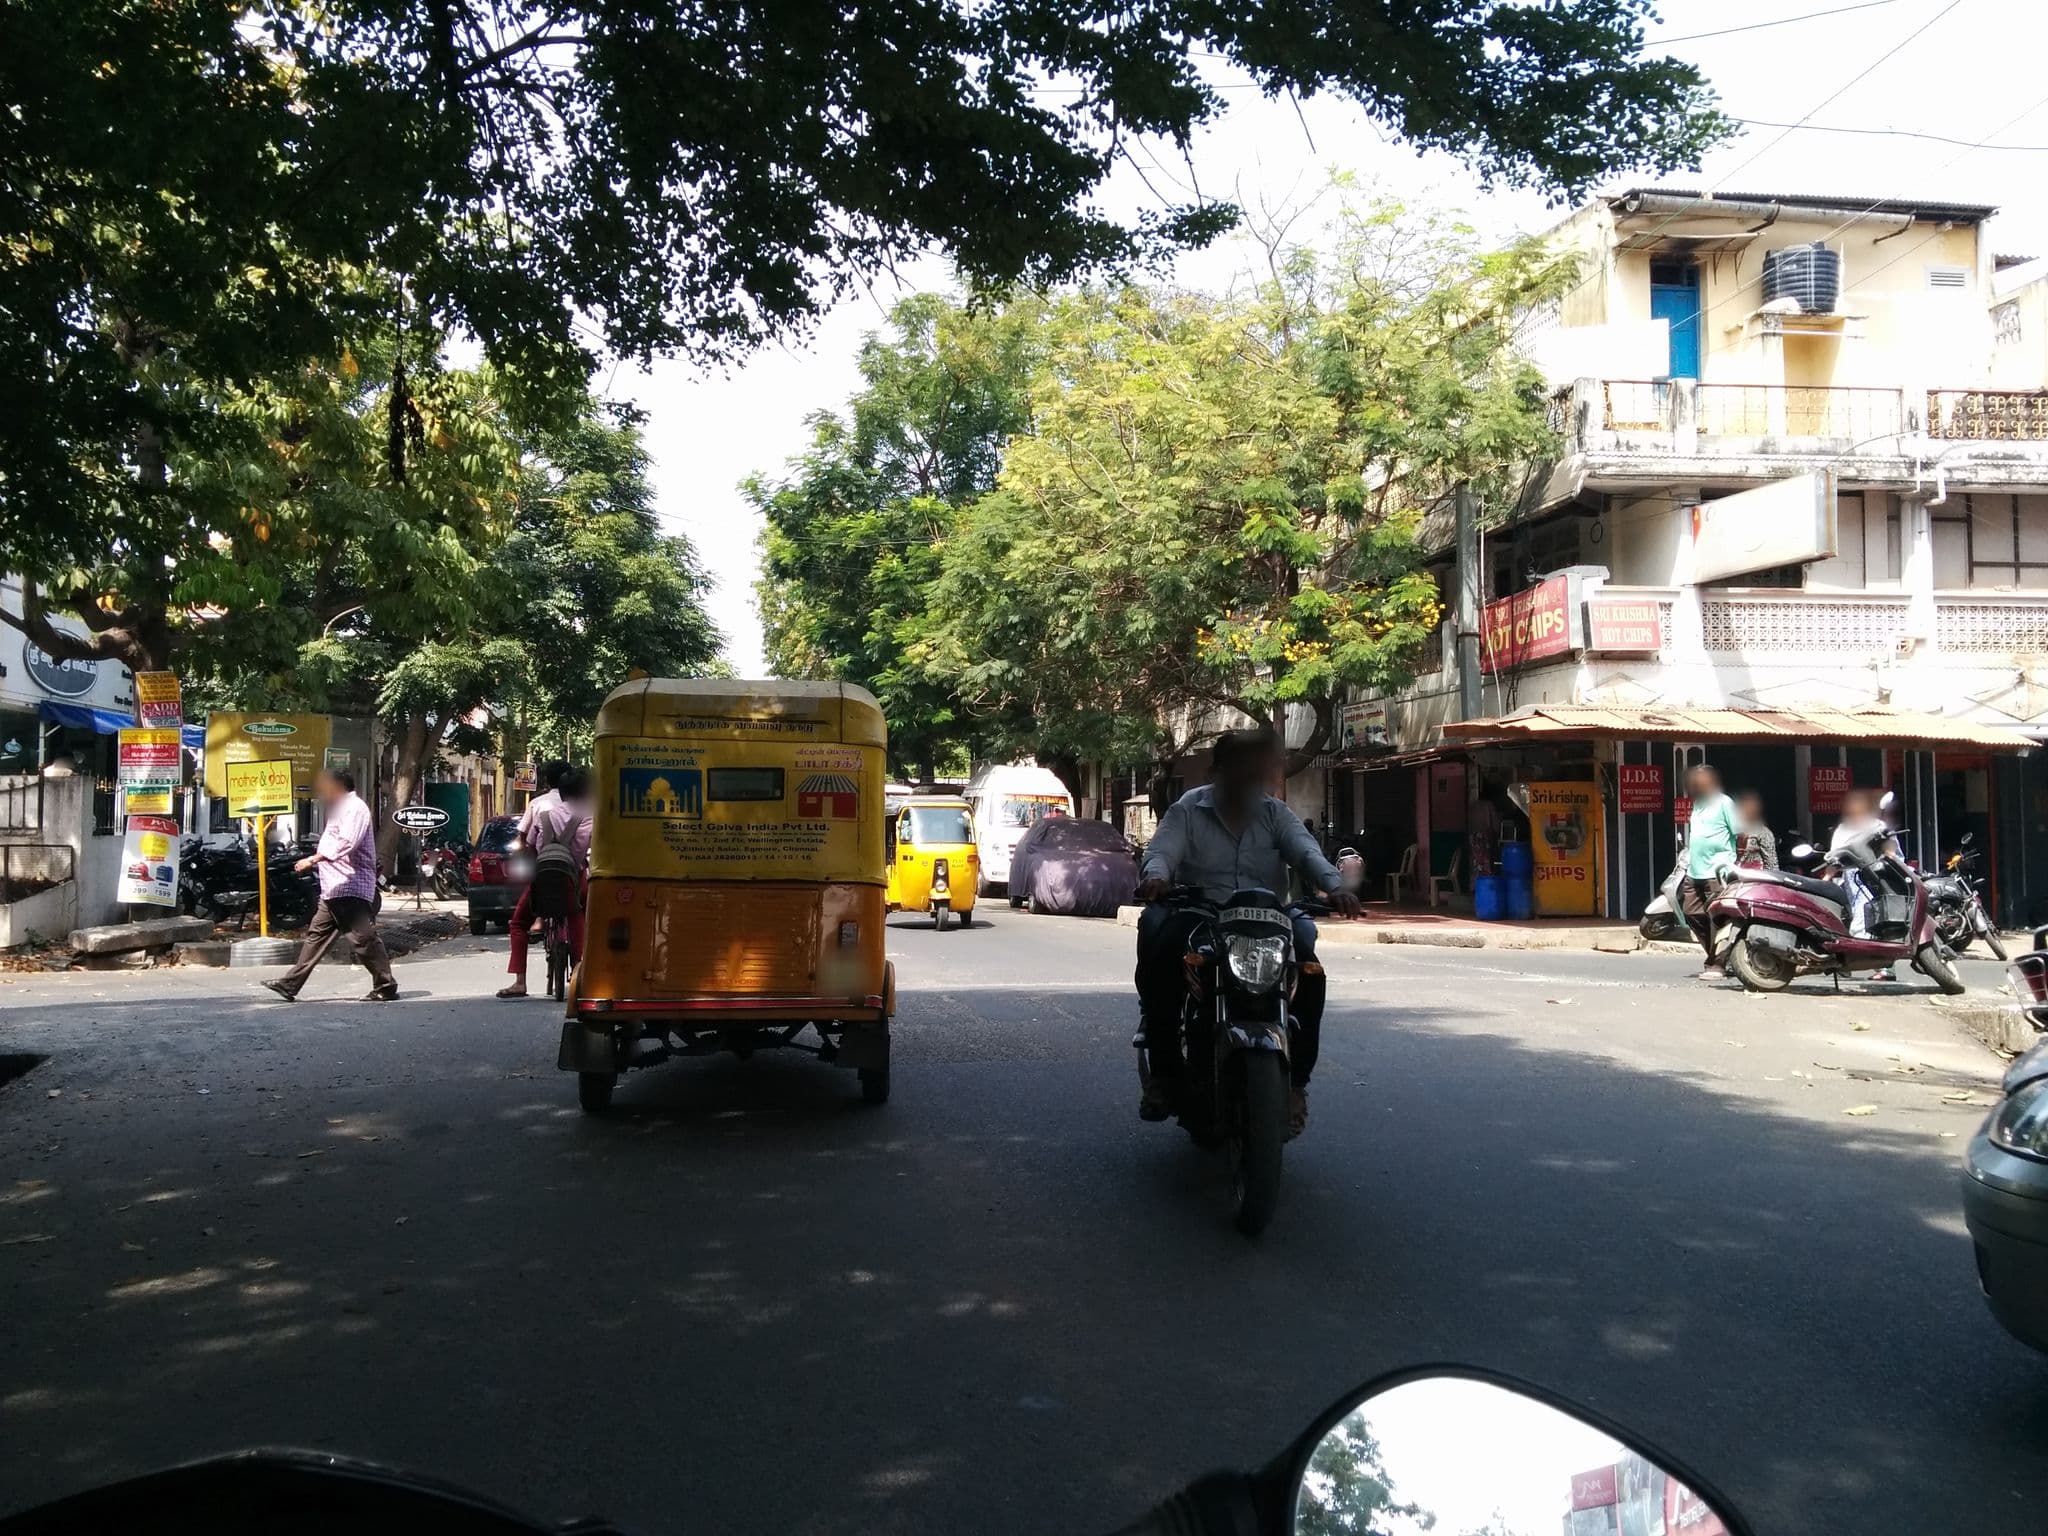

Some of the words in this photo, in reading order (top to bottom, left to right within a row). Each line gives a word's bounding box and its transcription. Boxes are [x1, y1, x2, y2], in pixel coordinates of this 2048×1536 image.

[1593, 606, 1609, 621] SRI
[1612, 606, 1655, 621] KRISHNA
[1515, 607, 1565, 645] CHIPS
[1600, 627, 1621, 642] HOT
[1623, 627, 1653, 642] CHIPS
[142, 702, 179, 712] CADD
[1622, 769, 1660, 783] J.D.R
[1815, 769, 1847, 781] J.D.R
[663, 821, 703, 831] Select
[706, 823, 743, 831] Galva
[747, 823, 778, 831] India
[782, 823, 802, 831] Pvt
[806, 823, 830, 831] Ltd.
[1535, 866, 1586, 881] CHIPS
